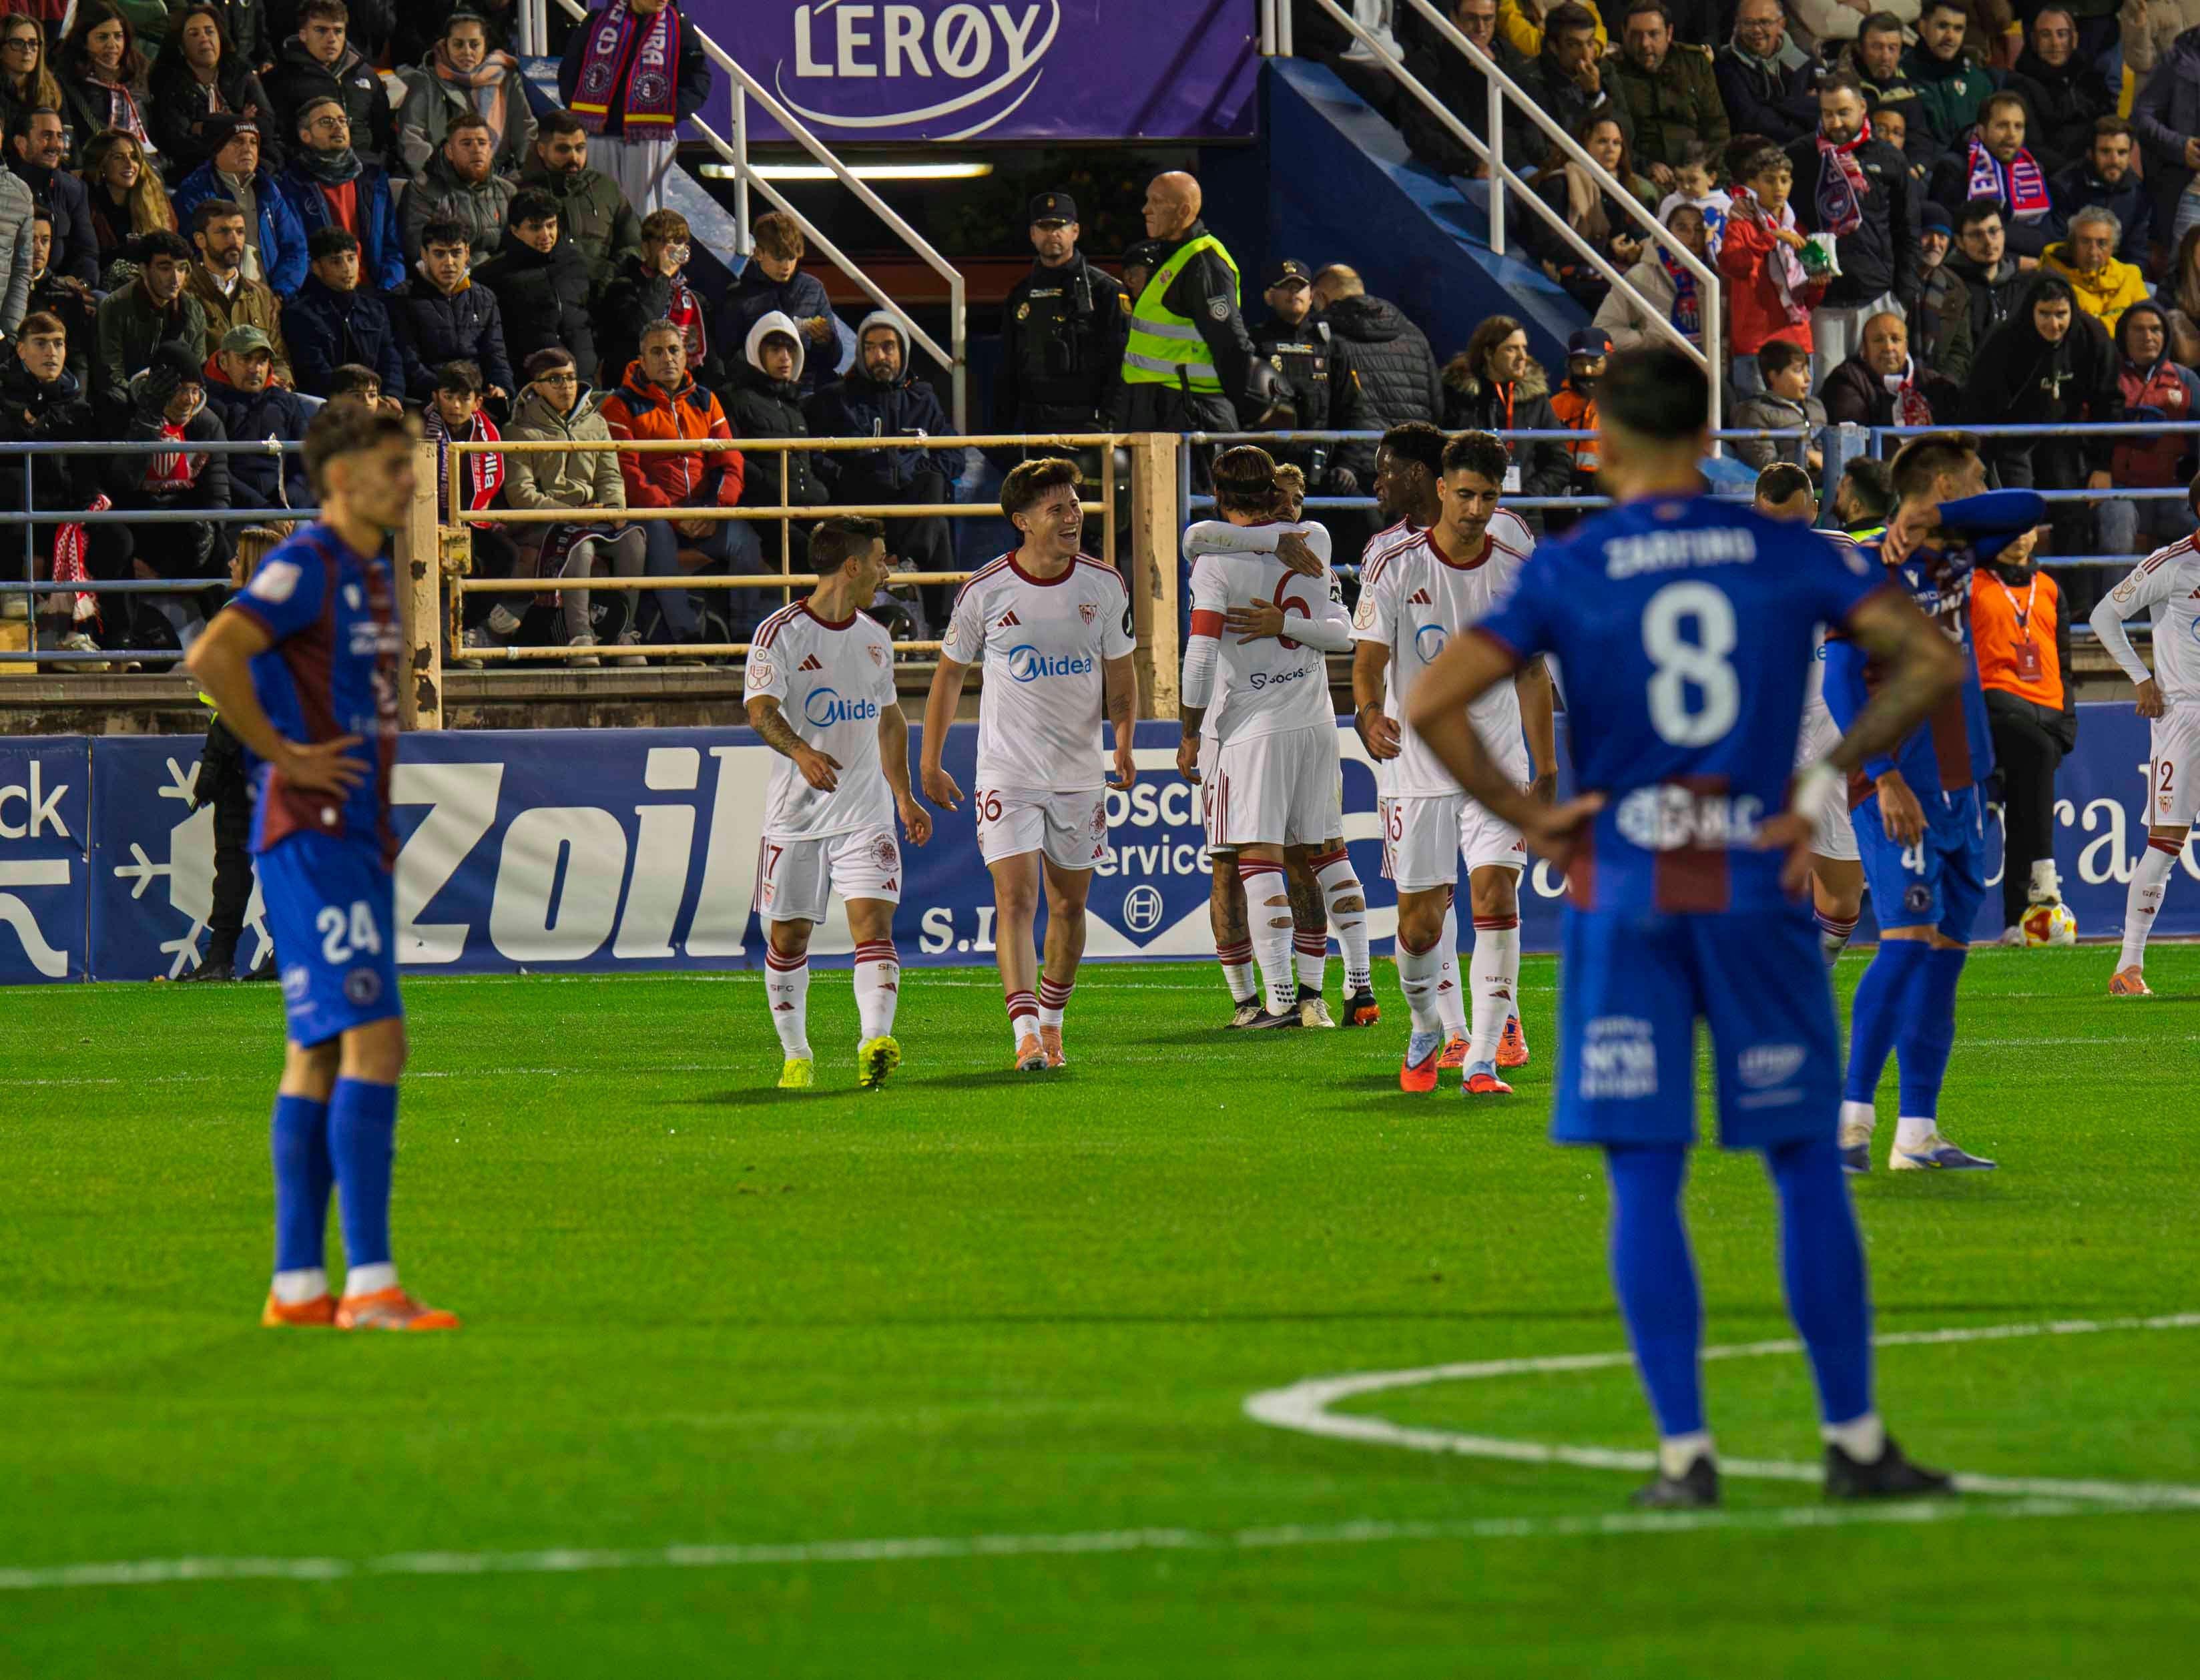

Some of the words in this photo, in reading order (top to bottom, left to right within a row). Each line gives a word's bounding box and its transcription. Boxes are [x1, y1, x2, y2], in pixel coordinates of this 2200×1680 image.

[794, 3, 1041, 79] LERØY
[1642, 581, 1739, 747] 8
[2160, 761, 2174, 792] 2
[391, 746, 856, 964] Zoil
[1095, 834, 1214, 877] ervice
[1901, 832, 1926, 875] 4
[316, 900, 382, 964] 24
[769, 984, 794, 993] SFC
